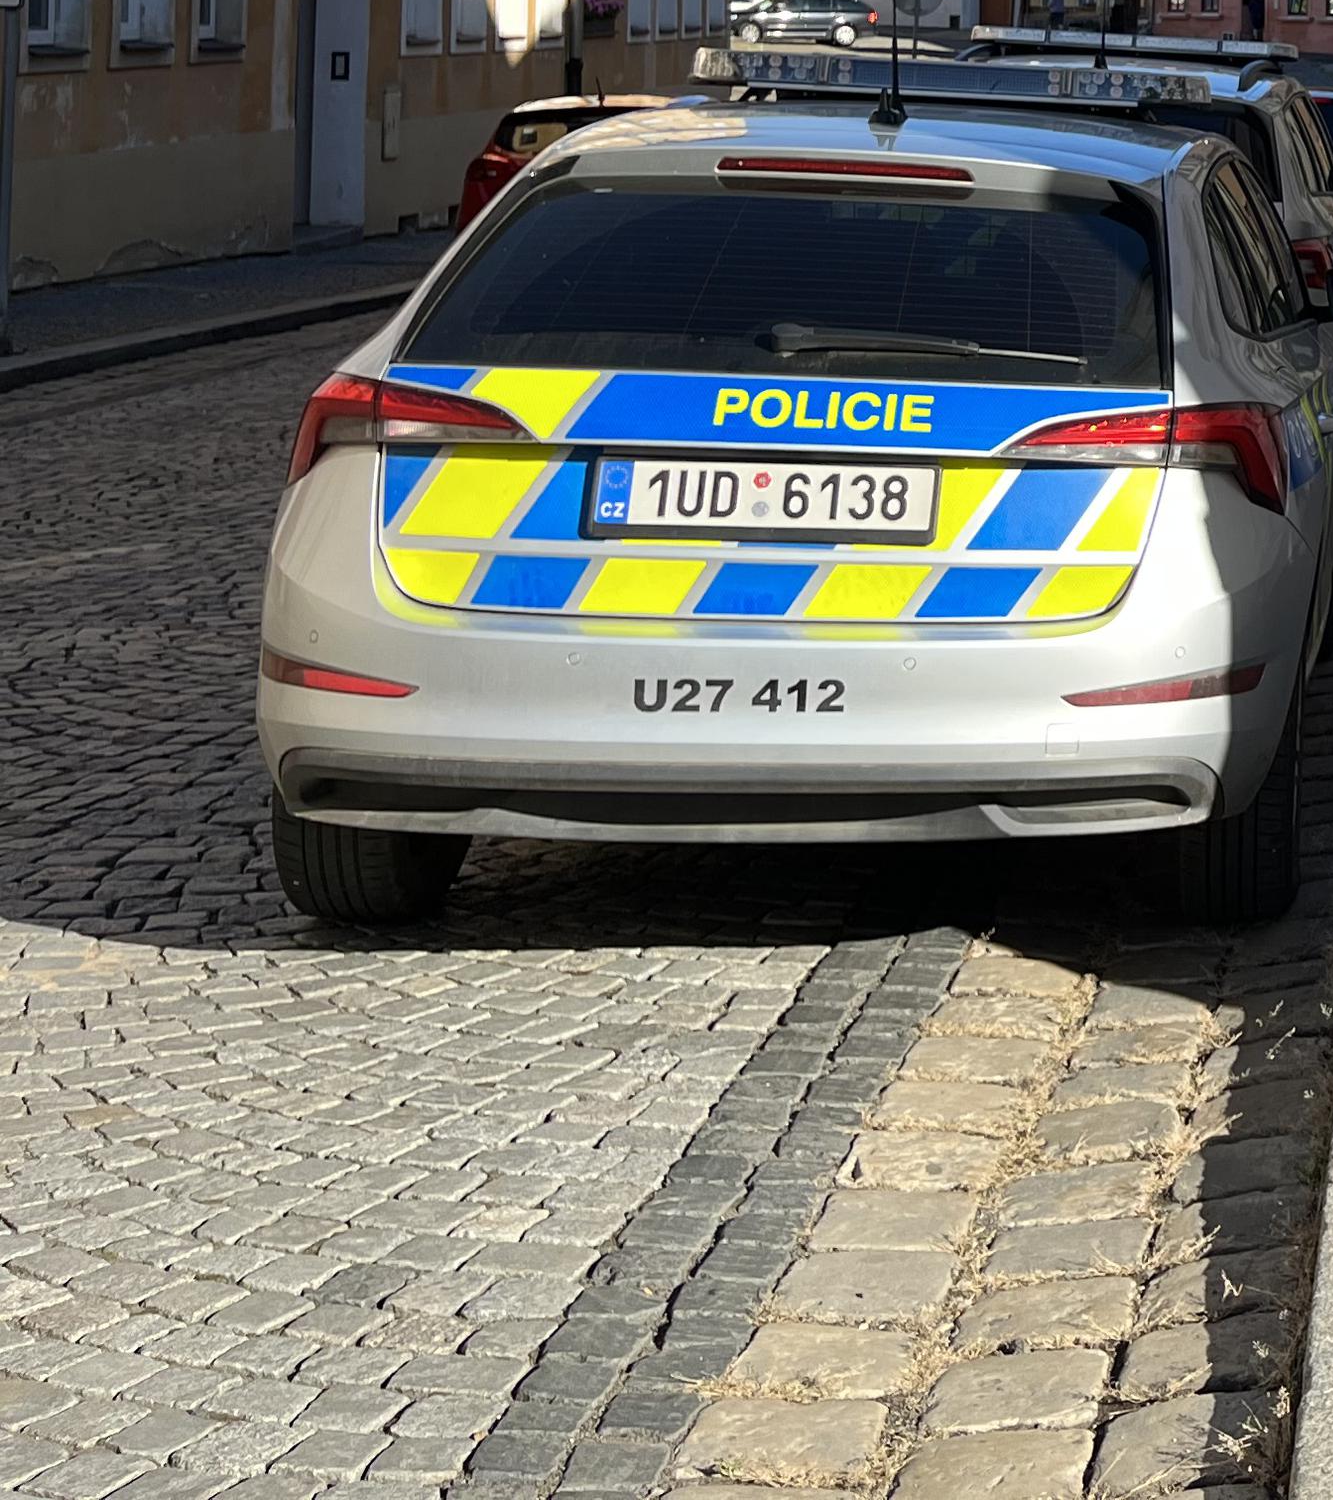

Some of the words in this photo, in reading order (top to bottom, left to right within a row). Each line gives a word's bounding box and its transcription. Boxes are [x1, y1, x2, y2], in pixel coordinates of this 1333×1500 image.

[713, 388, 935, 433] POLICIE
[600, 501, 625, 518] CZ
[648, 469, 740, 518] 1UD
[782, 472, 909, 520] 6138
[634, 678, 734, 712] U27
[751, 678, 846, 712] 412
